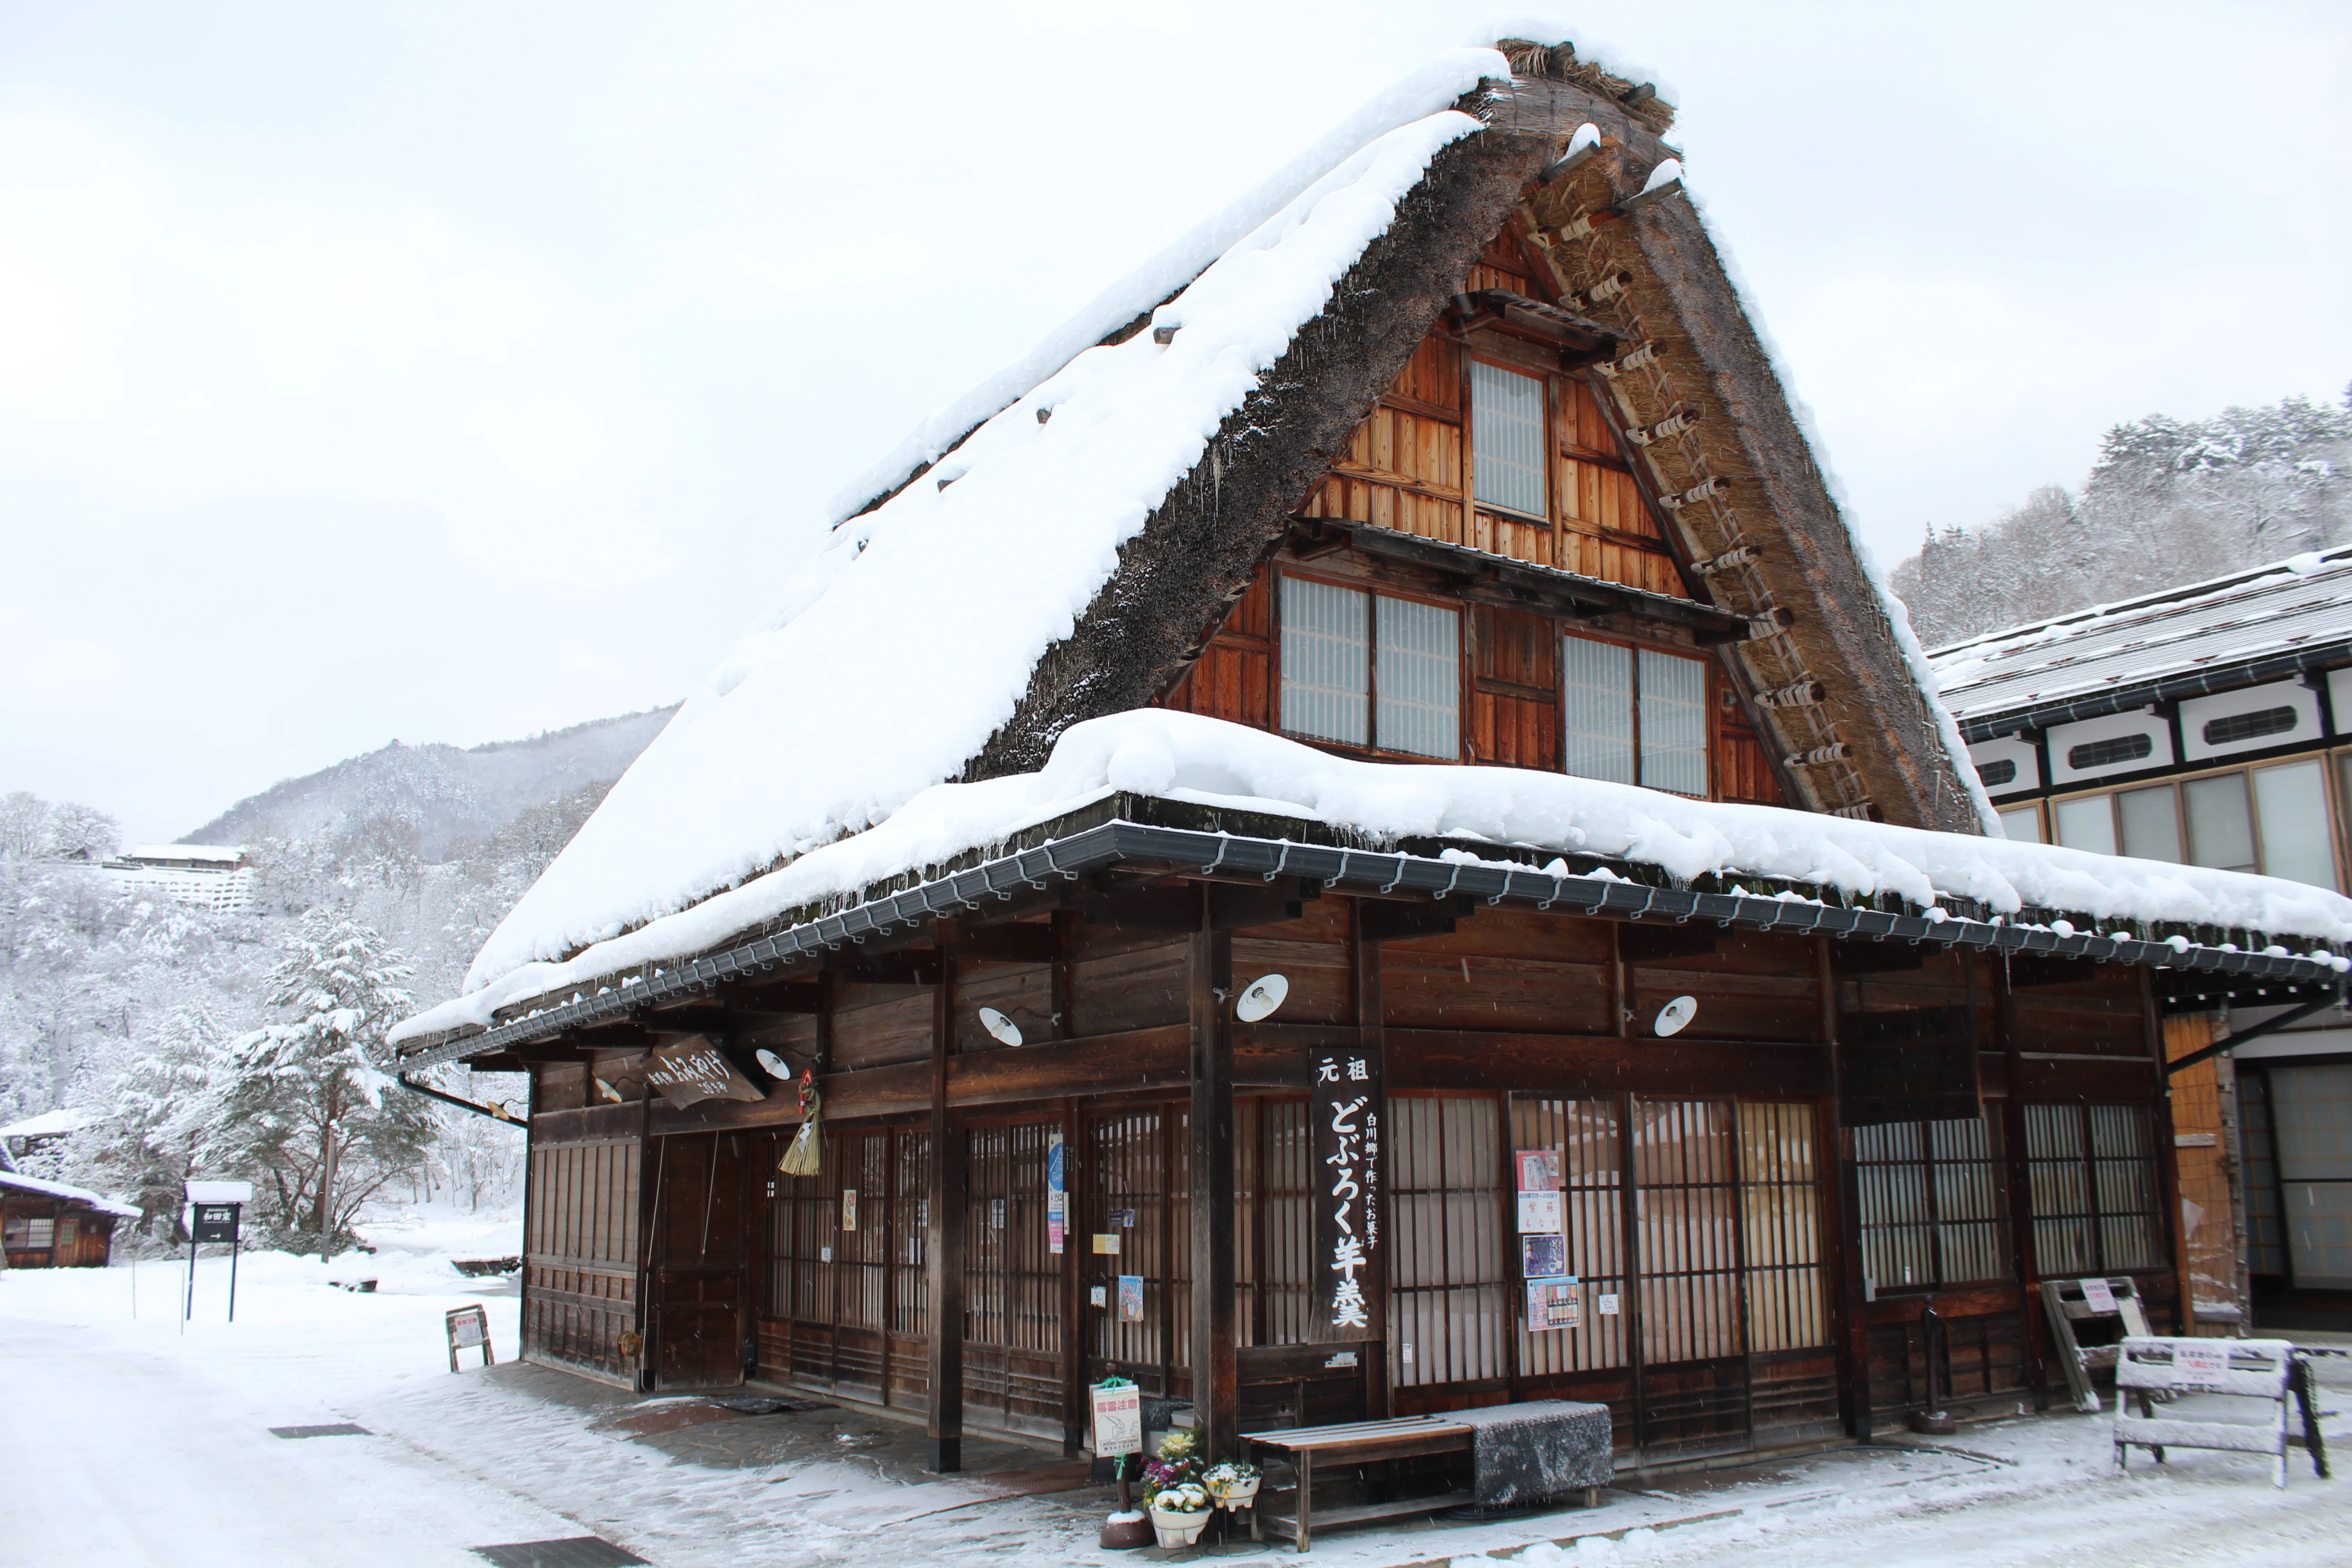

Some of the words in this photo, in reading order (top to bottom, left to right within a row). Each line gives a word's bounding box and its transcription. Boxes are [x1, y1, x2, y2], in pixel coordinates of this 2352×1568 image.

[660, 1049, 730, 1083] おみやげ
[1318, 1056, 1369, 1082] 元祖
[1365, 1112, 1378, 1250] 白川郷で作ったお菓子
[203, 1212, 231, 1221] 和田家
[1326, 1096, 1368, 1328] どぶろく羊羹
